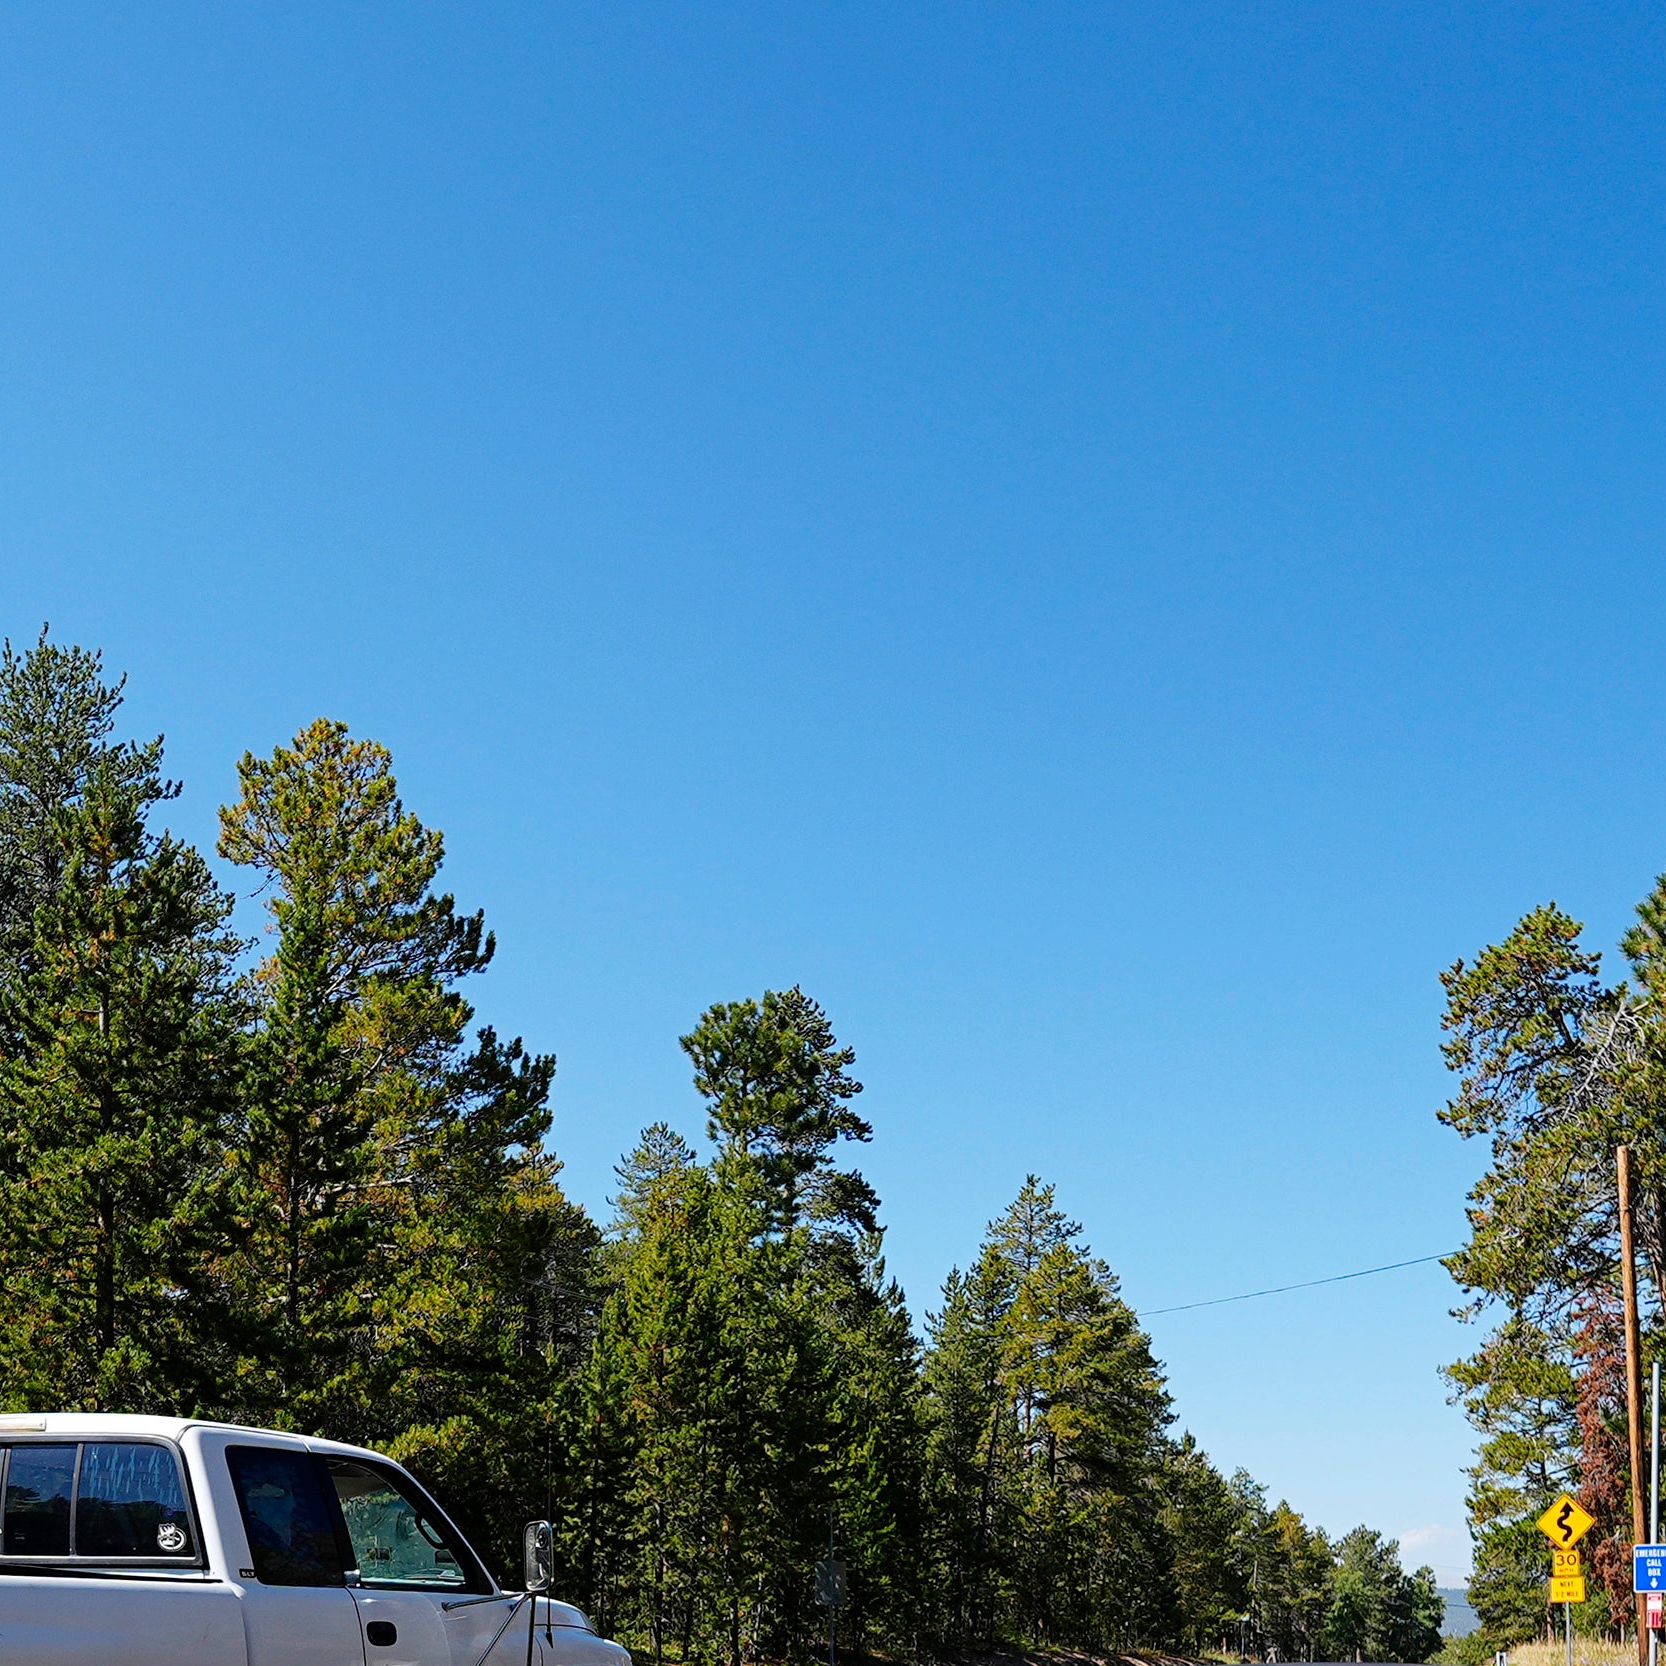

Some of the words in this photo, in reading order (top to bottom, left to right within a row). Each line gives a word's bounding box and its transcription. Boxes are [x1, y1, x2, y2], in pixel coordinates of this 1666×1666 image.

[1556, 1554, 1577, 1566] 30
[1646, 1558, 1662, 1567] CALL
[1647, 1568, 1661, 1576] BOX
